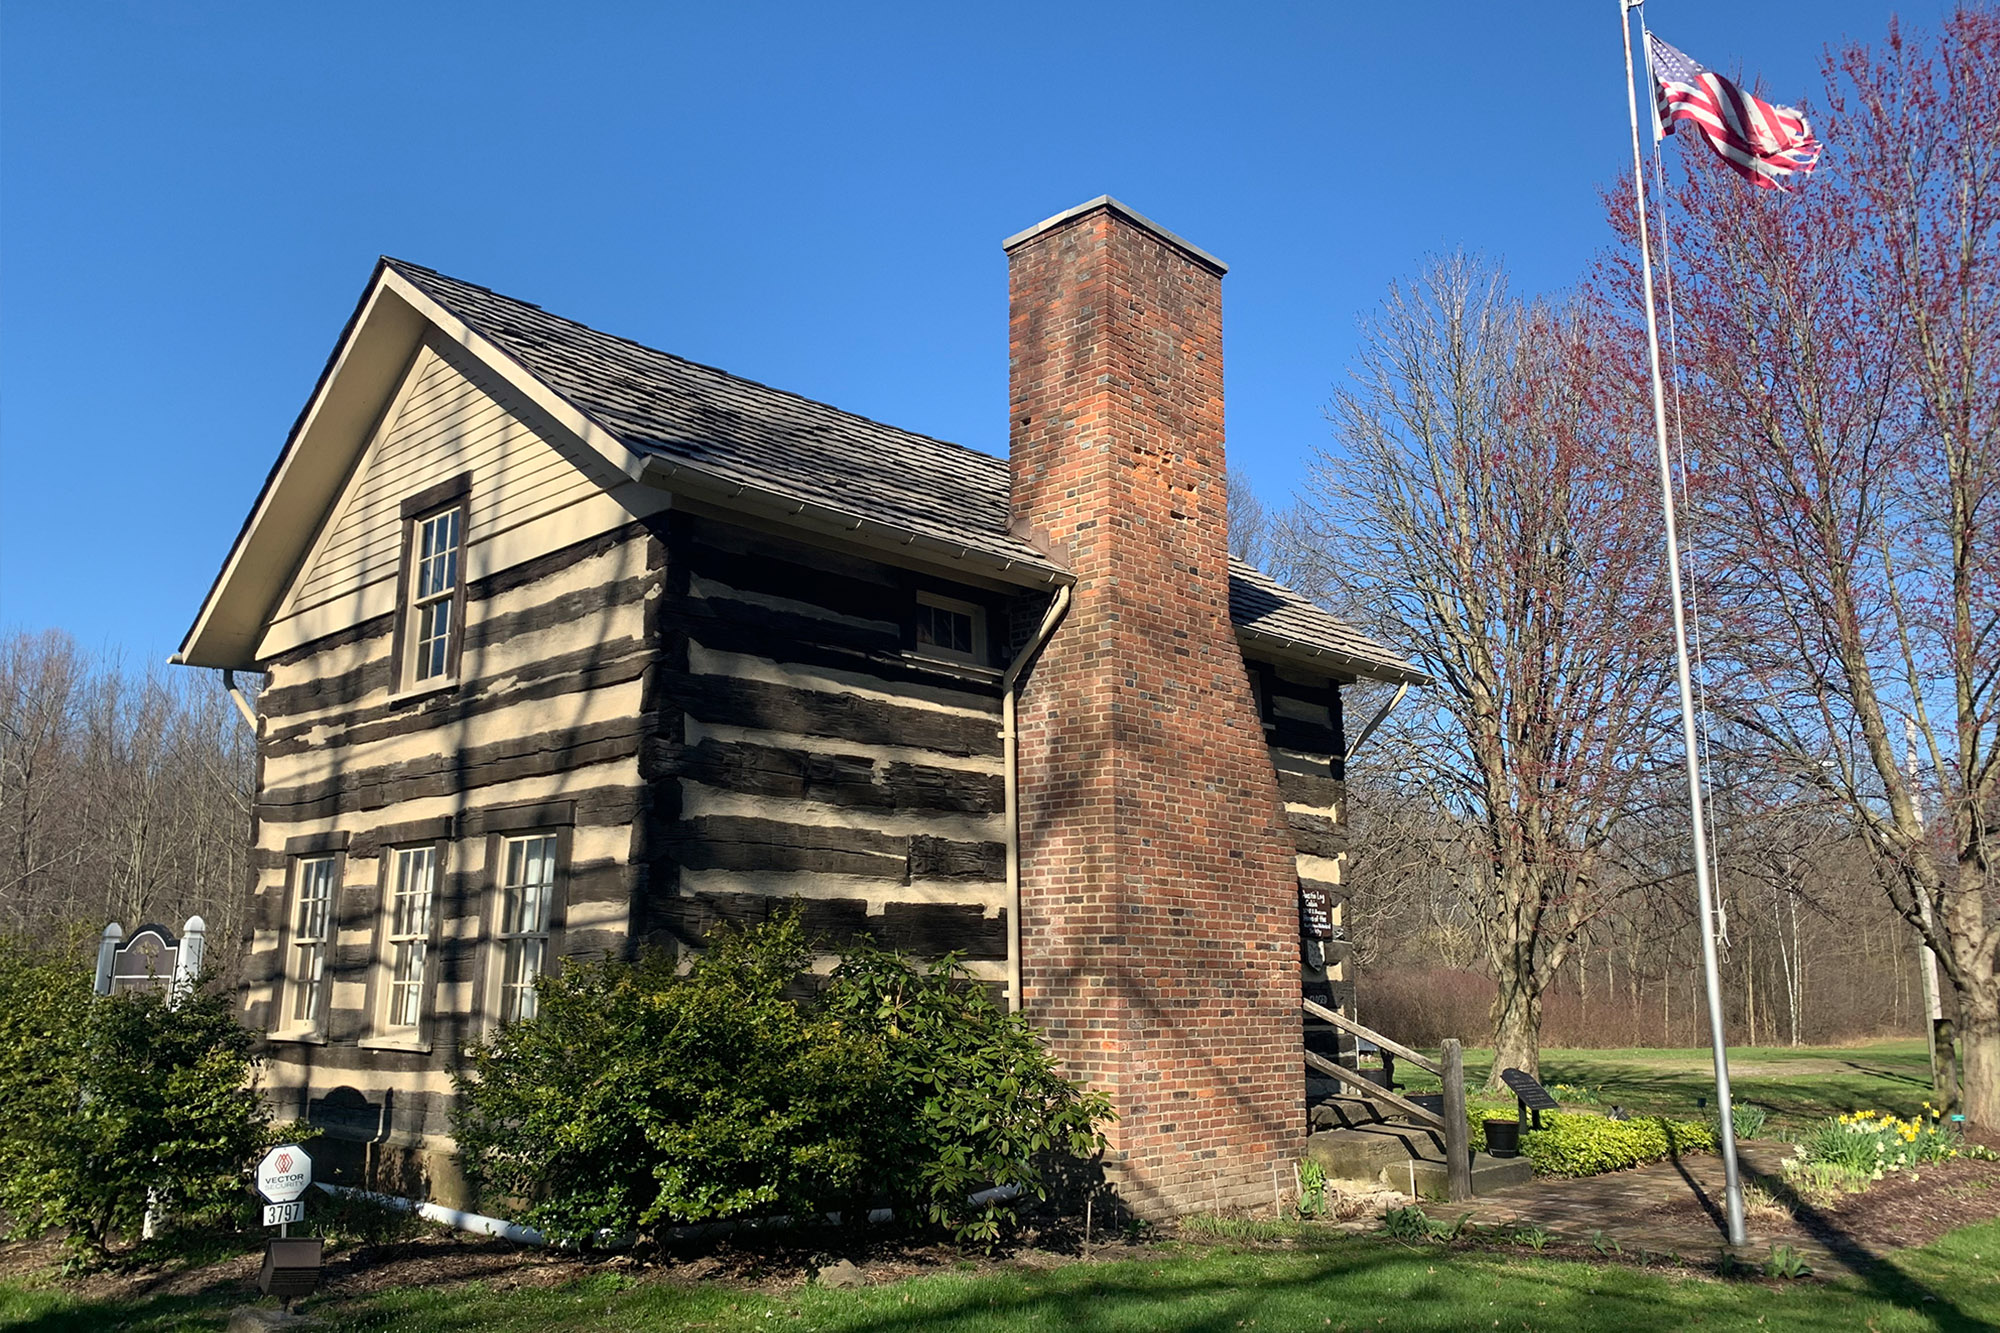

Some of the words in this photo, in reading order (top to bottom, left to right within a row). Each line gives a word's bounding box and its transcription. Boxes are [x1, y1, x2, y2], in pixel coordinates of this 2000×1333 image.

[265, 1173, 305, 1185] VECTOR
[264, 1180, 304, 1192] SECURITY
[268, 1203, 300, 1225] 3797
